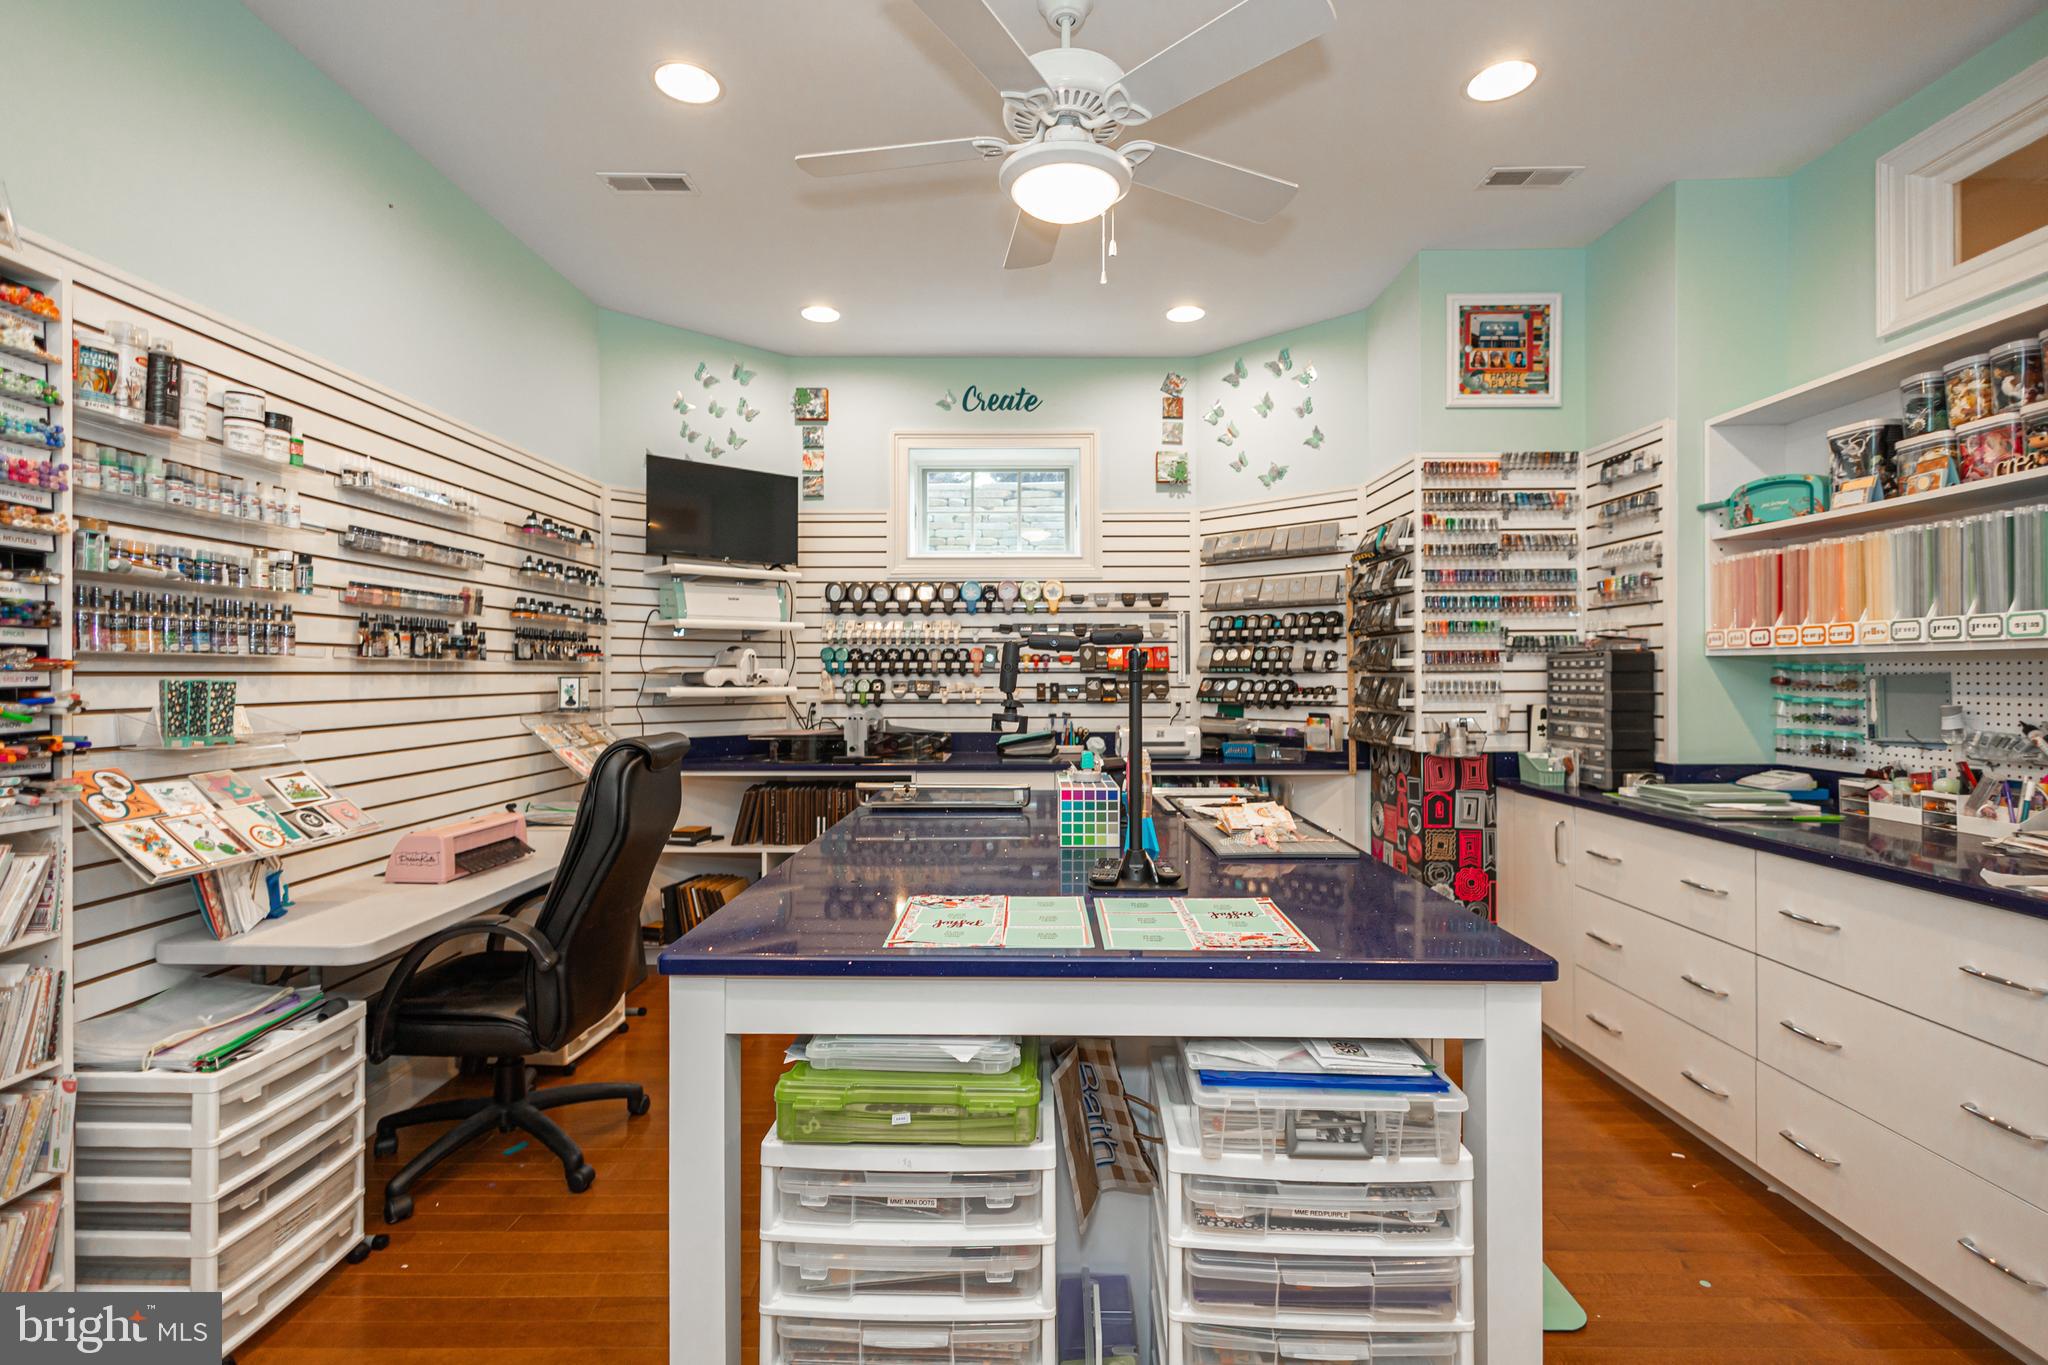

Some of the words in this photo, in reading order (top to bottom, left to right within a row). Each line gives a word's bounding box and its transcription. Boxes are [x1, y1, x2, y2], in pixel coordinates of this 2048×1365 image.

[1491, 380, 1521, 388] PLACE
[962, 385, 1043, 412] Create
[21, 492, 43, 503] VIOLET
[3, 535, 38, 546] NEUTRALS
[25, 675, 39, 683] POP
[1079, 1061, 1118, 1168] Bath
[1310, 1210, 1349, 1219] RED/PURPLE
